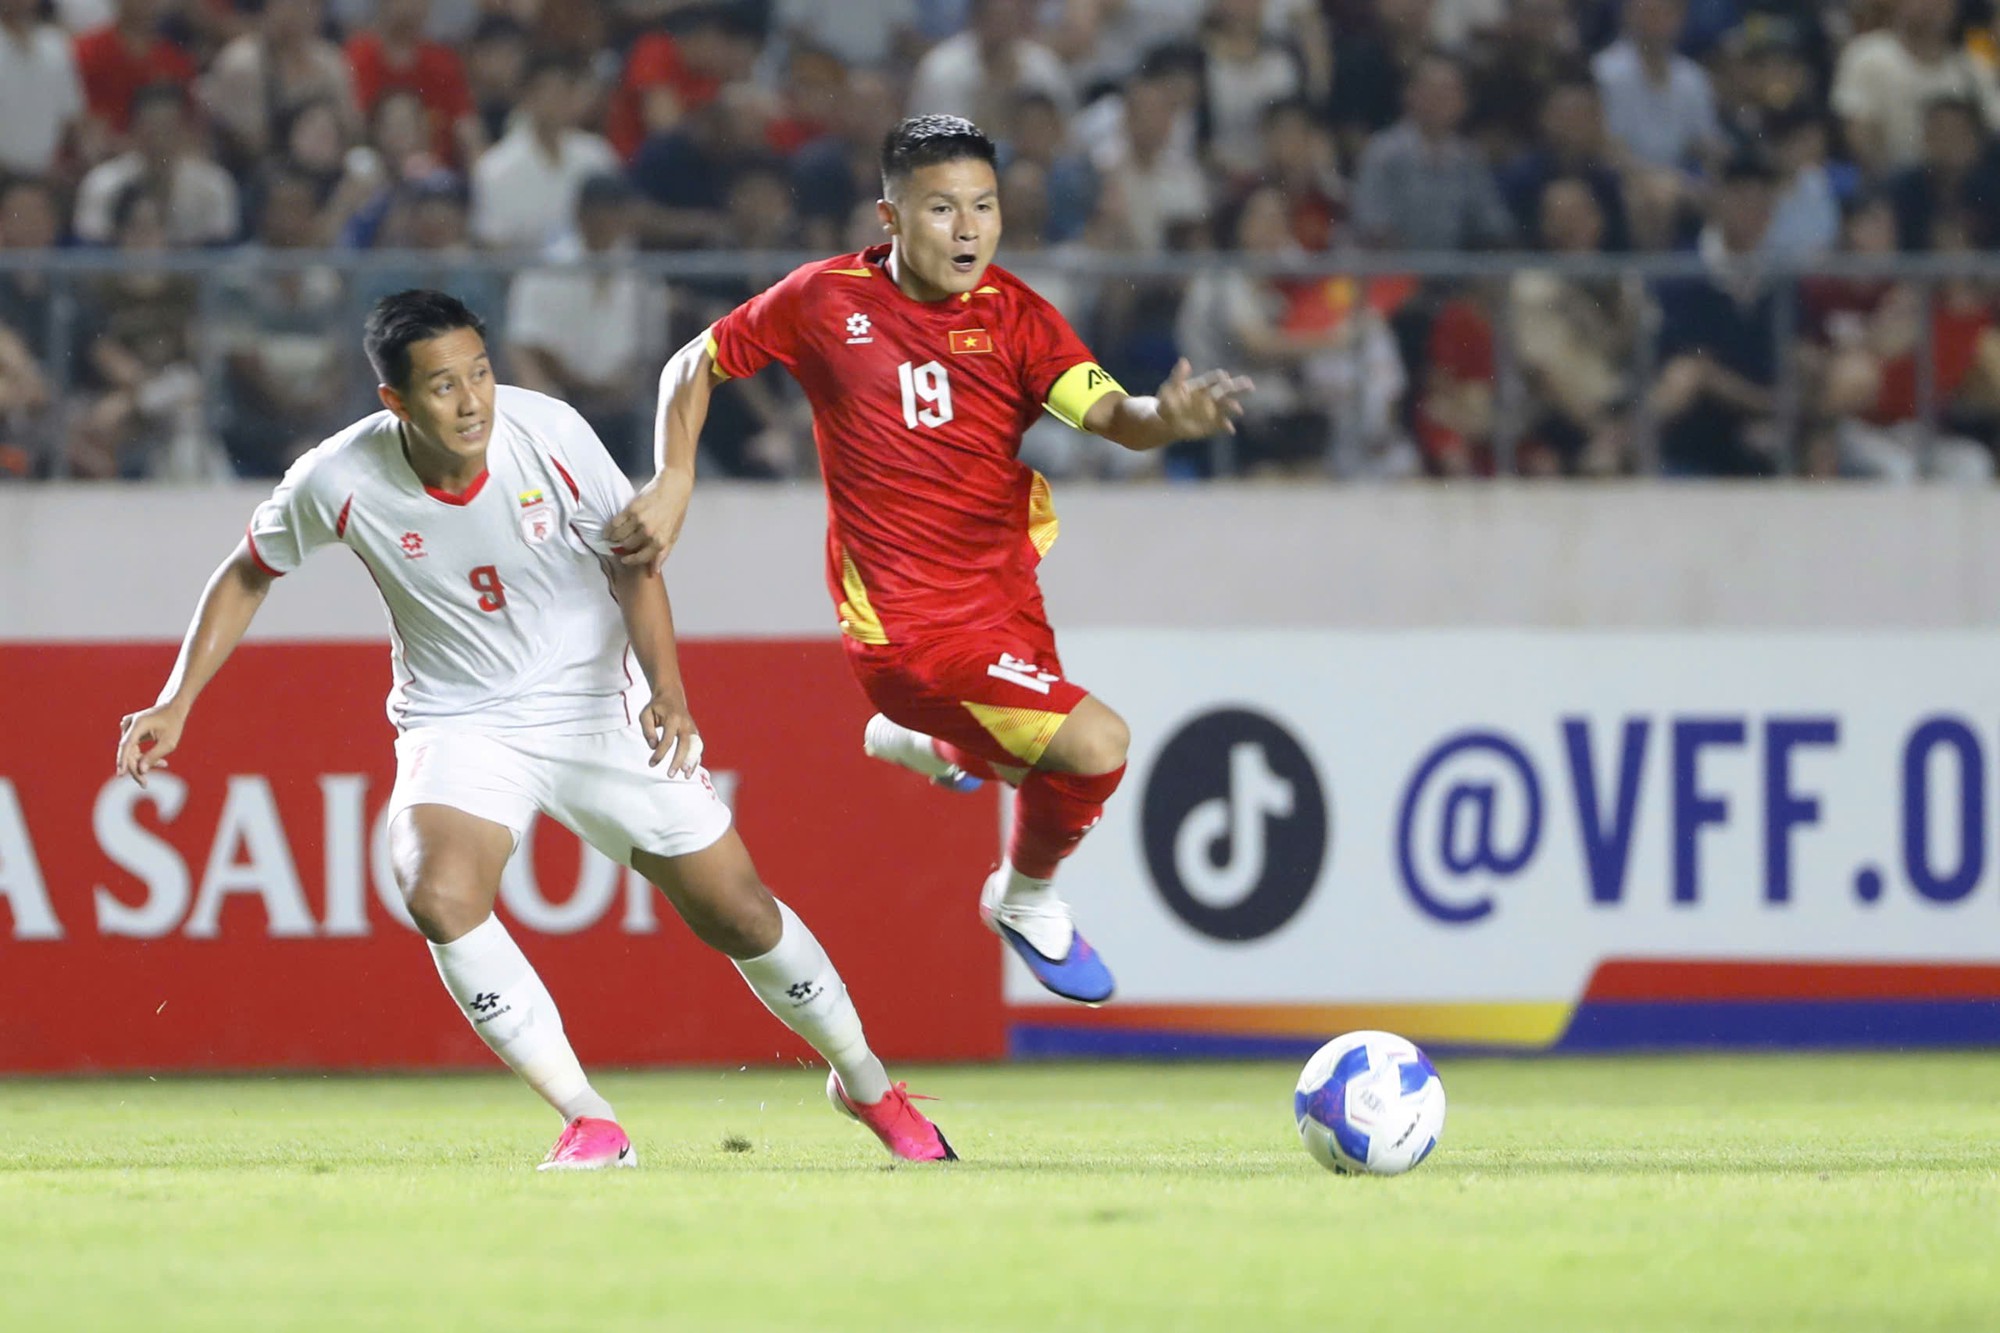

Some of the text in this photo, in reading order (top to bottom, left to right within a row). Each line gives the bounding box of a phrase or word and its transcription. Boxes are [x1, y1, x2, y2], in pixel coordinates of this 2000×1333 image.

[898, 360, 954, 429] 19
[469, 564, 507, 612] 9
[1392, 714, 1987, 926] @VFF.O
